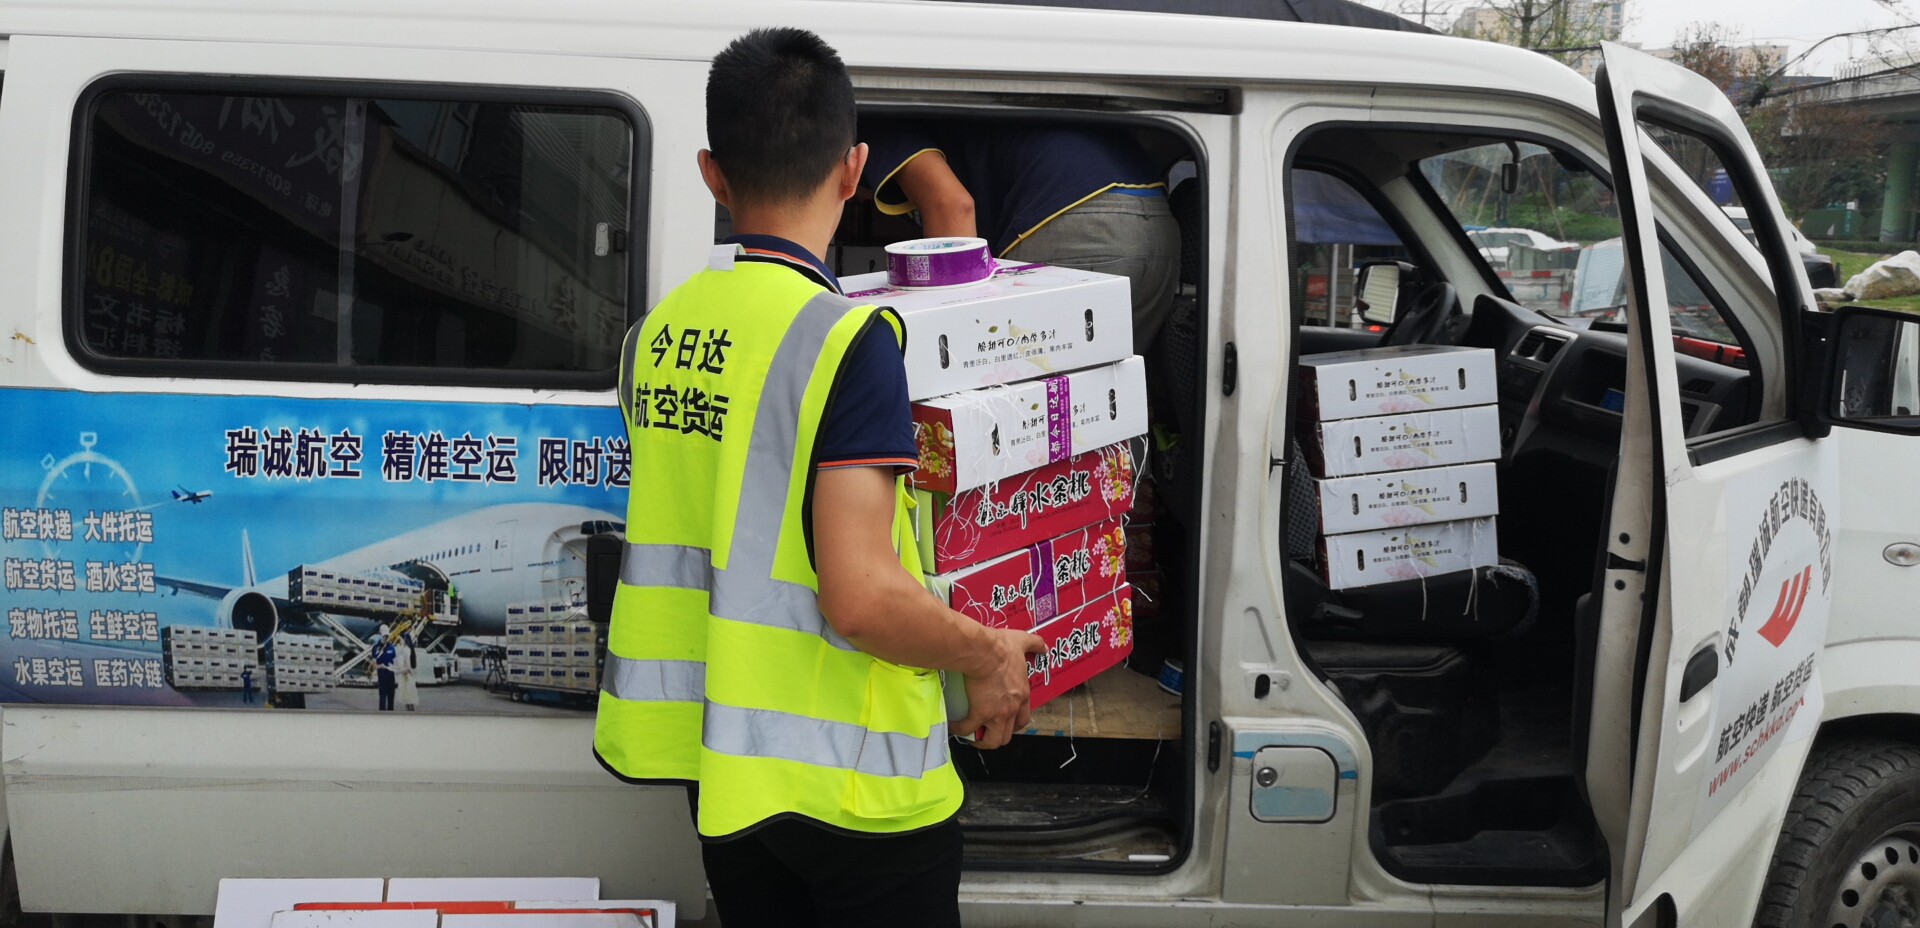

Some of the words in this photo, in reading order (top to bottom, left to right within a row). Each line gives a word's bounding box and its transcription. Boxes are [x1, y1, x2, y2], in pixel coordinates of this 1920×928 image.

[651, 323, 732, 374] 今日达
[634, 383, 730, 442] 航空货运
[226, 427, 361, 480] 瑞诚航空
[383, 430, 517, 484] 精准空运
[538, 436, 631, 488] 限时送
[3, 508, 72, 542] 航空快递
[84, 511, 153, 543] 大件托运
[5, 558, 75, 591] 航空货运
[86, 561, 155, 593] 酒水空运
[1724, 476, 1831, 667] 成都瑞诚航空快递有限公司
[9, 607, 78, 640] 宠物托运
[90, 610, 159, 642] 生鲜空运
[15, 656, 84, 688] 水果空运
[94, 659, 163, 688] 医药冷链
[1715, 690, 1770, 764] 航空快递
[1769, 652, 1816, 713] 航空货运
